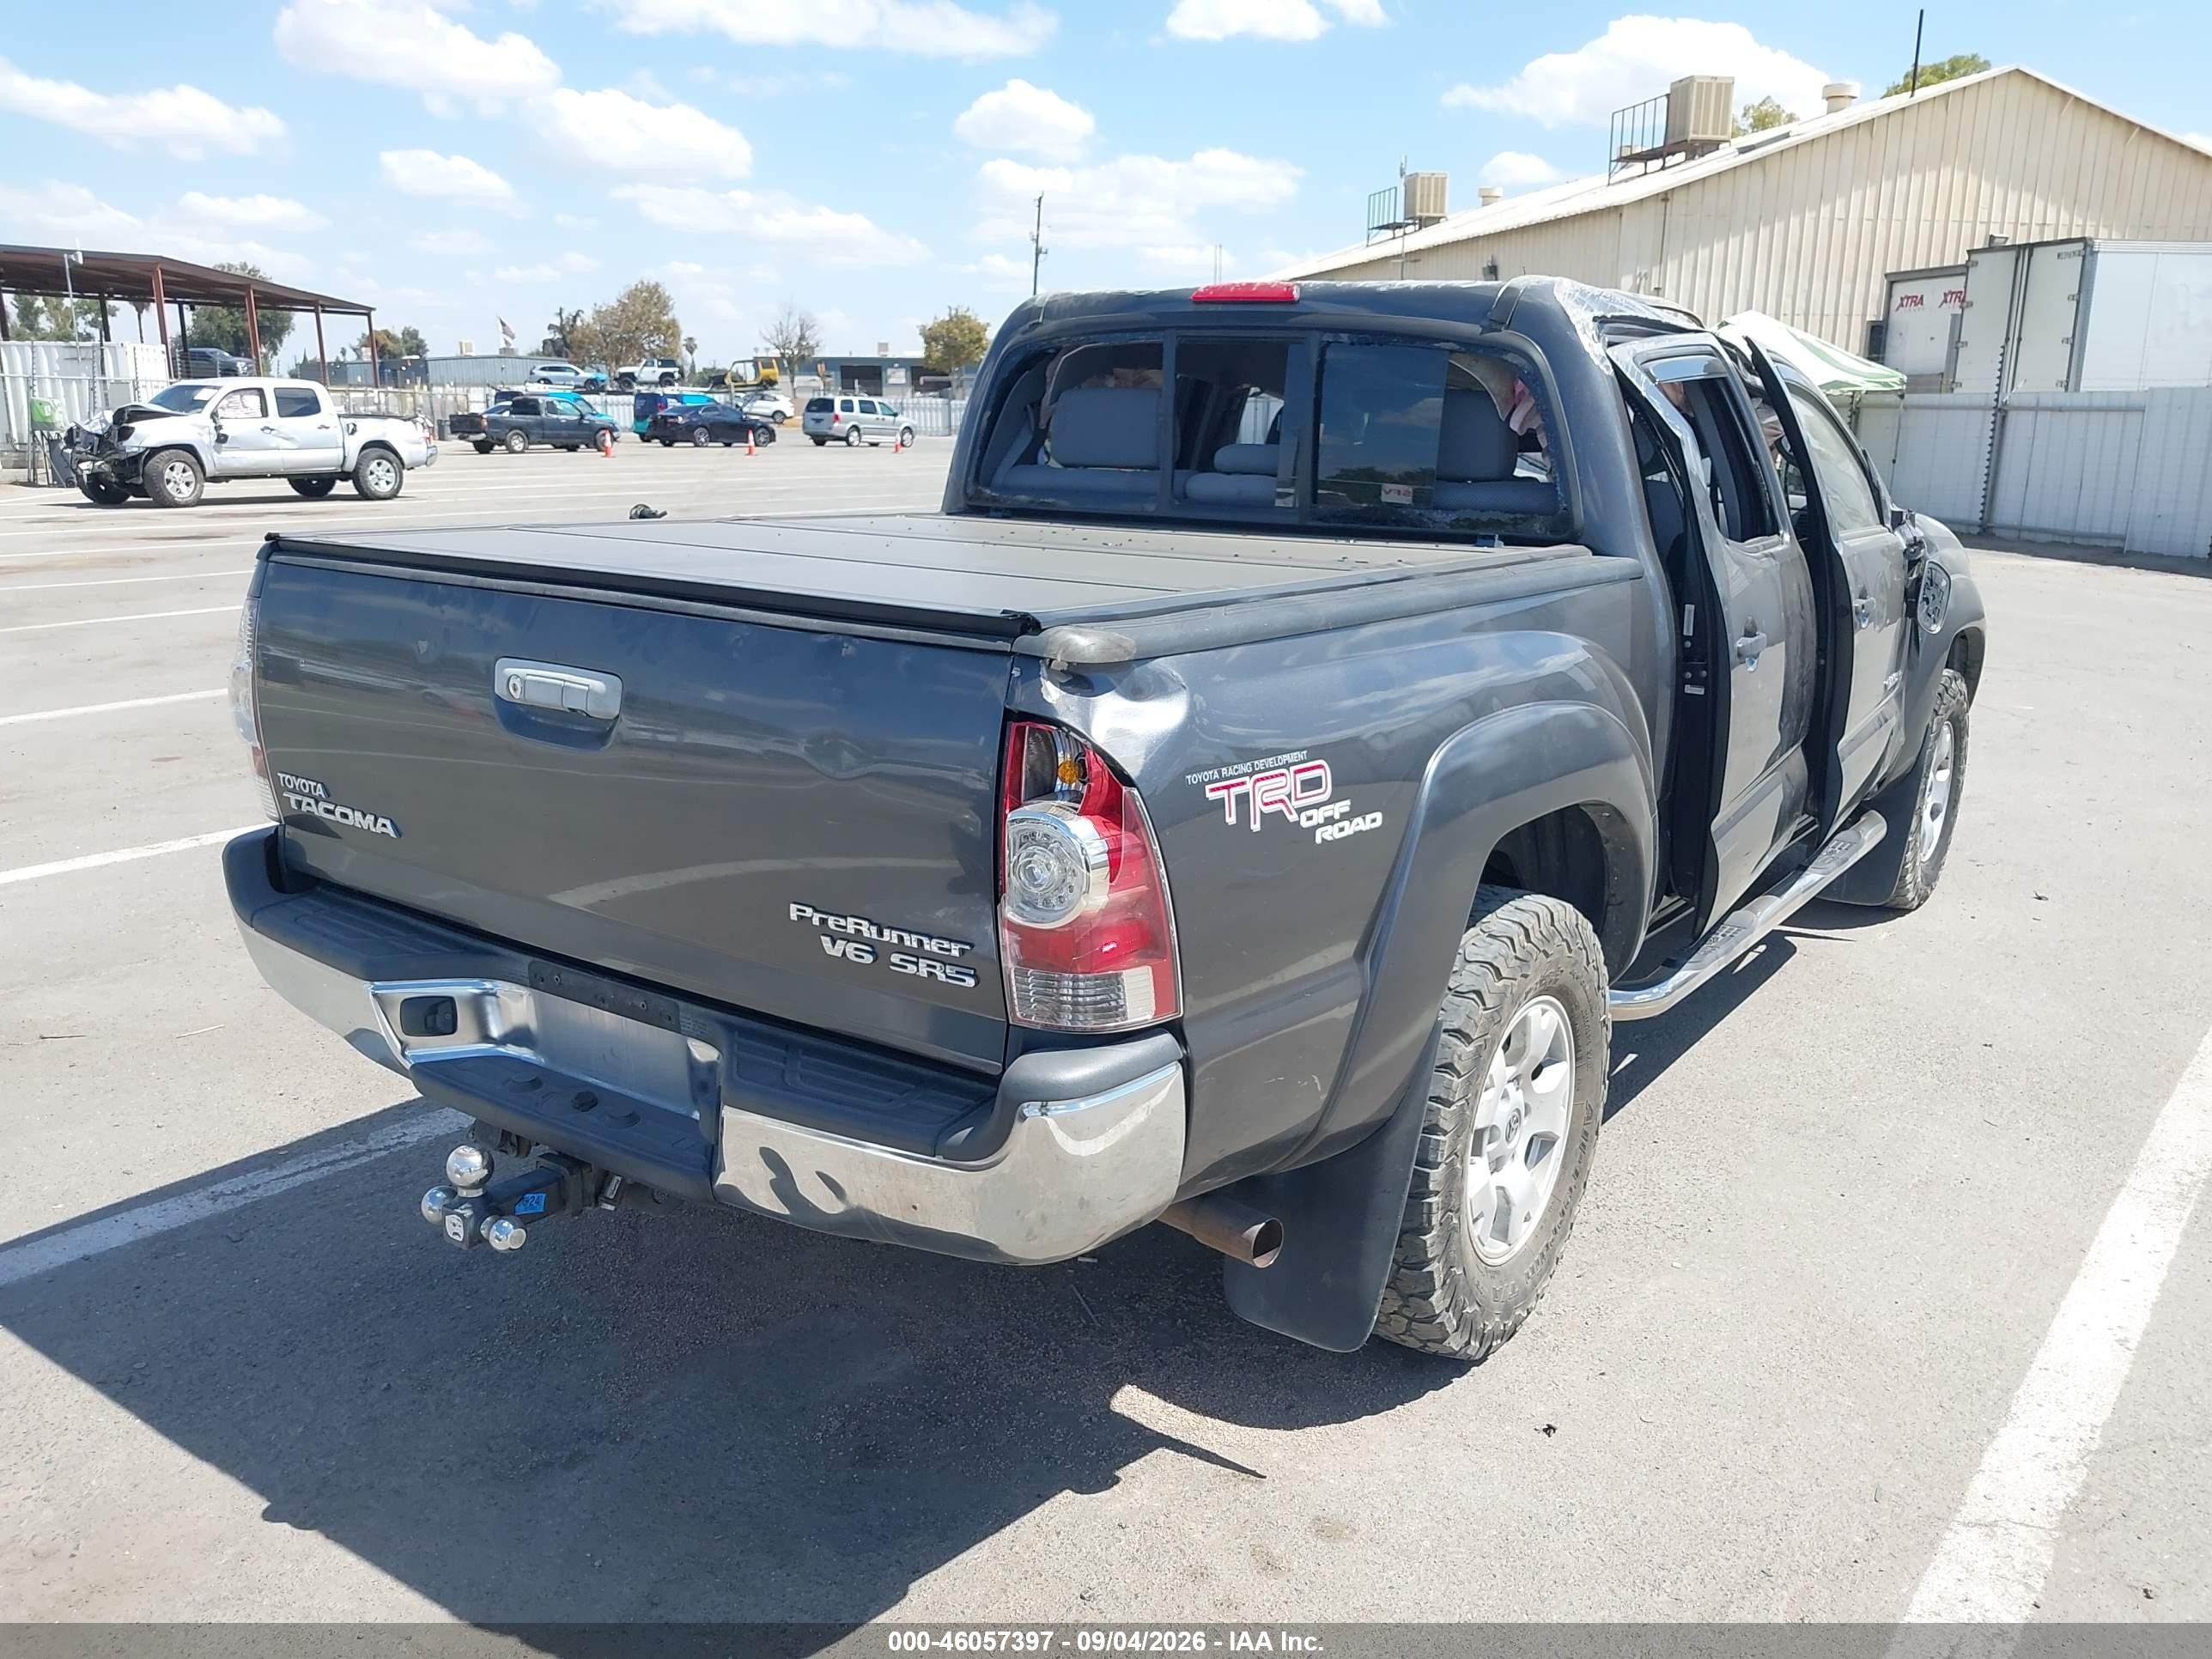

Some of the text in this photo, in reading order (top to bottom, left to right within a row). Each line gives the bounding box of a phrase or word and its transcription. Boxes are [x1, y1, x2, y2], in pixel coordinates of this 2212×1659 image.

[1895, 294, 1924, 312] XTRA
[276, 772, 328, 799] TOYOTA
[1186, 750, 1308, 786] TOYOTA RACING DEVELOPMENT
[1205, 759, 1333, 832] TRD
[283, 791, 399, 839] TACOMA
[1300, 799, 1352, 829] OFF
[1315, 811, 1383, 845] ROAD
[789, 902, 973, 958] PreRunner
[819, 933, 977, 988] V6 SR5
